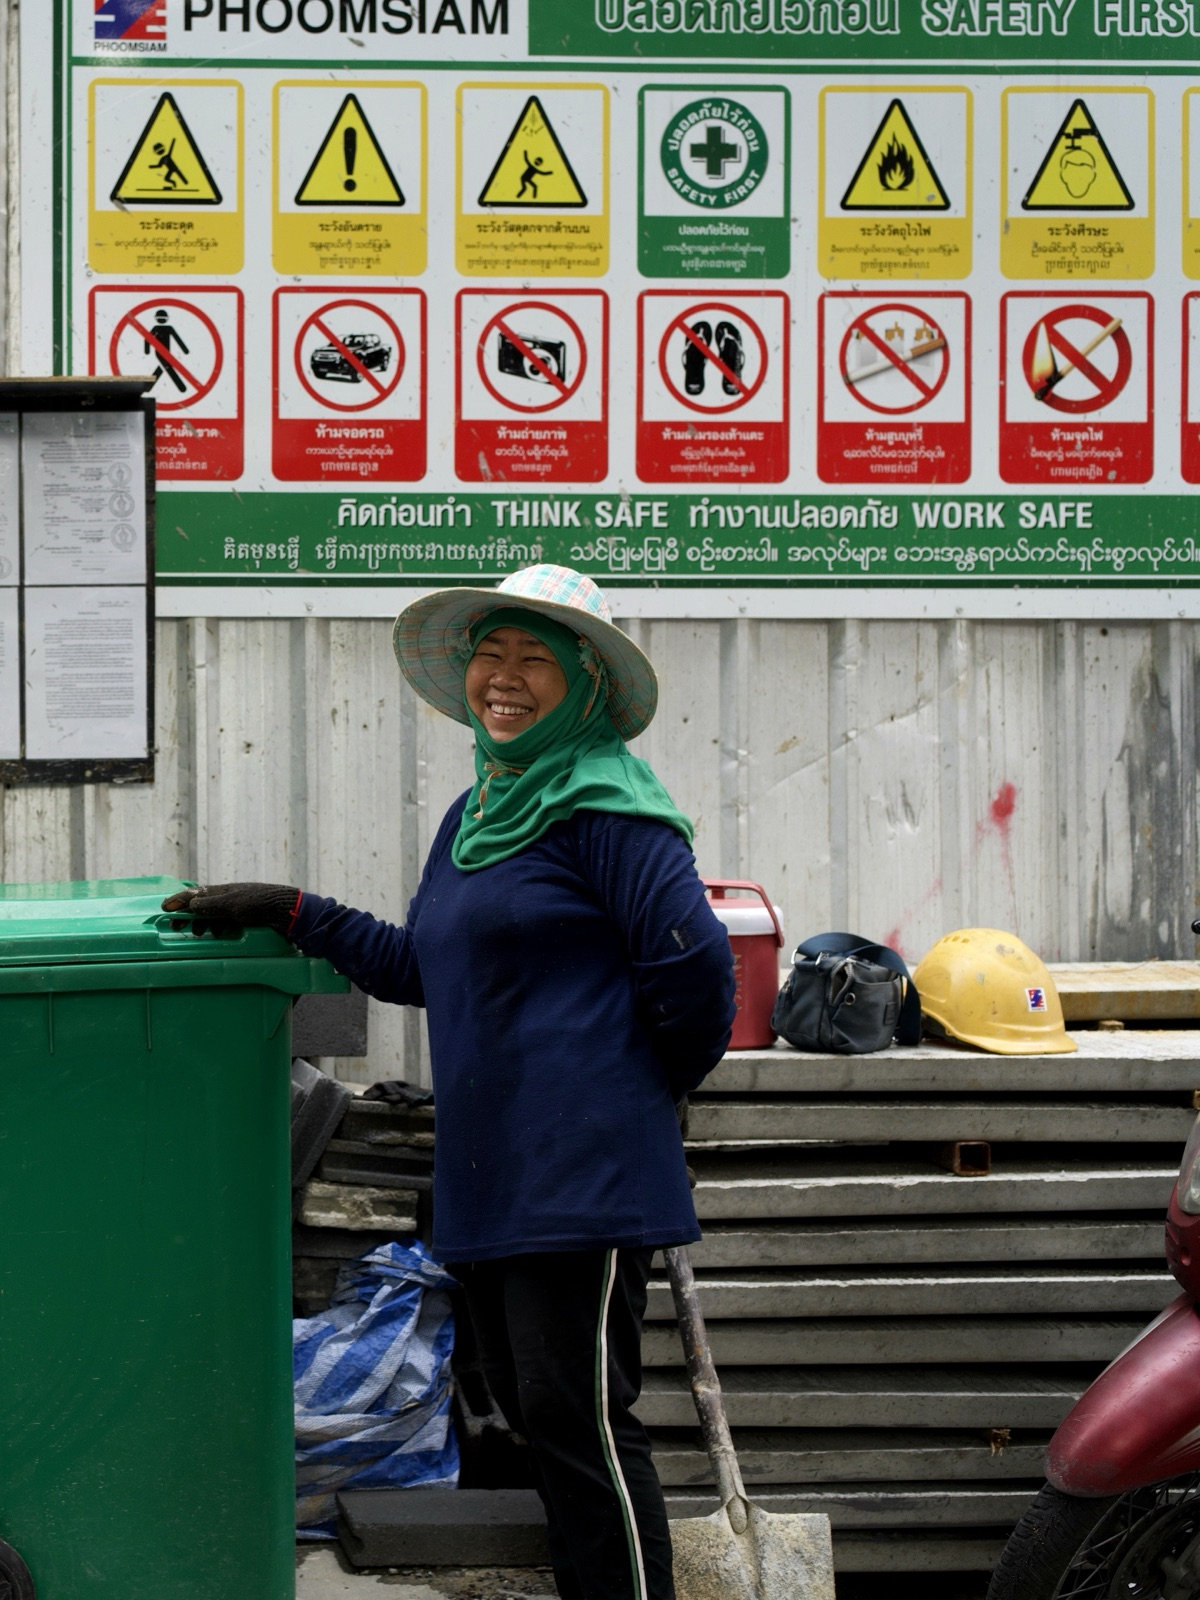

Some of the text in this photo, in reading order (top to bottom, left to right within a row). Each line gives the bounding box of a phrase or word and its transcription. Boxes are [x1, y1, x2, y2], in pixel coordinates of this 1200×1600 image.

[183, 0, 510, 35] PHOOMSIAM
[921, 0, 1075, 36] SAFETY
[93, 42, 168, 52] PHOOMSIAM
[667, 167, 761, 206] SAFETY FIRST
[337, 496, 1093, 530] คิดก่อนทำ THINK SAFE ทำงานปลอดภัย WORK SAFE
